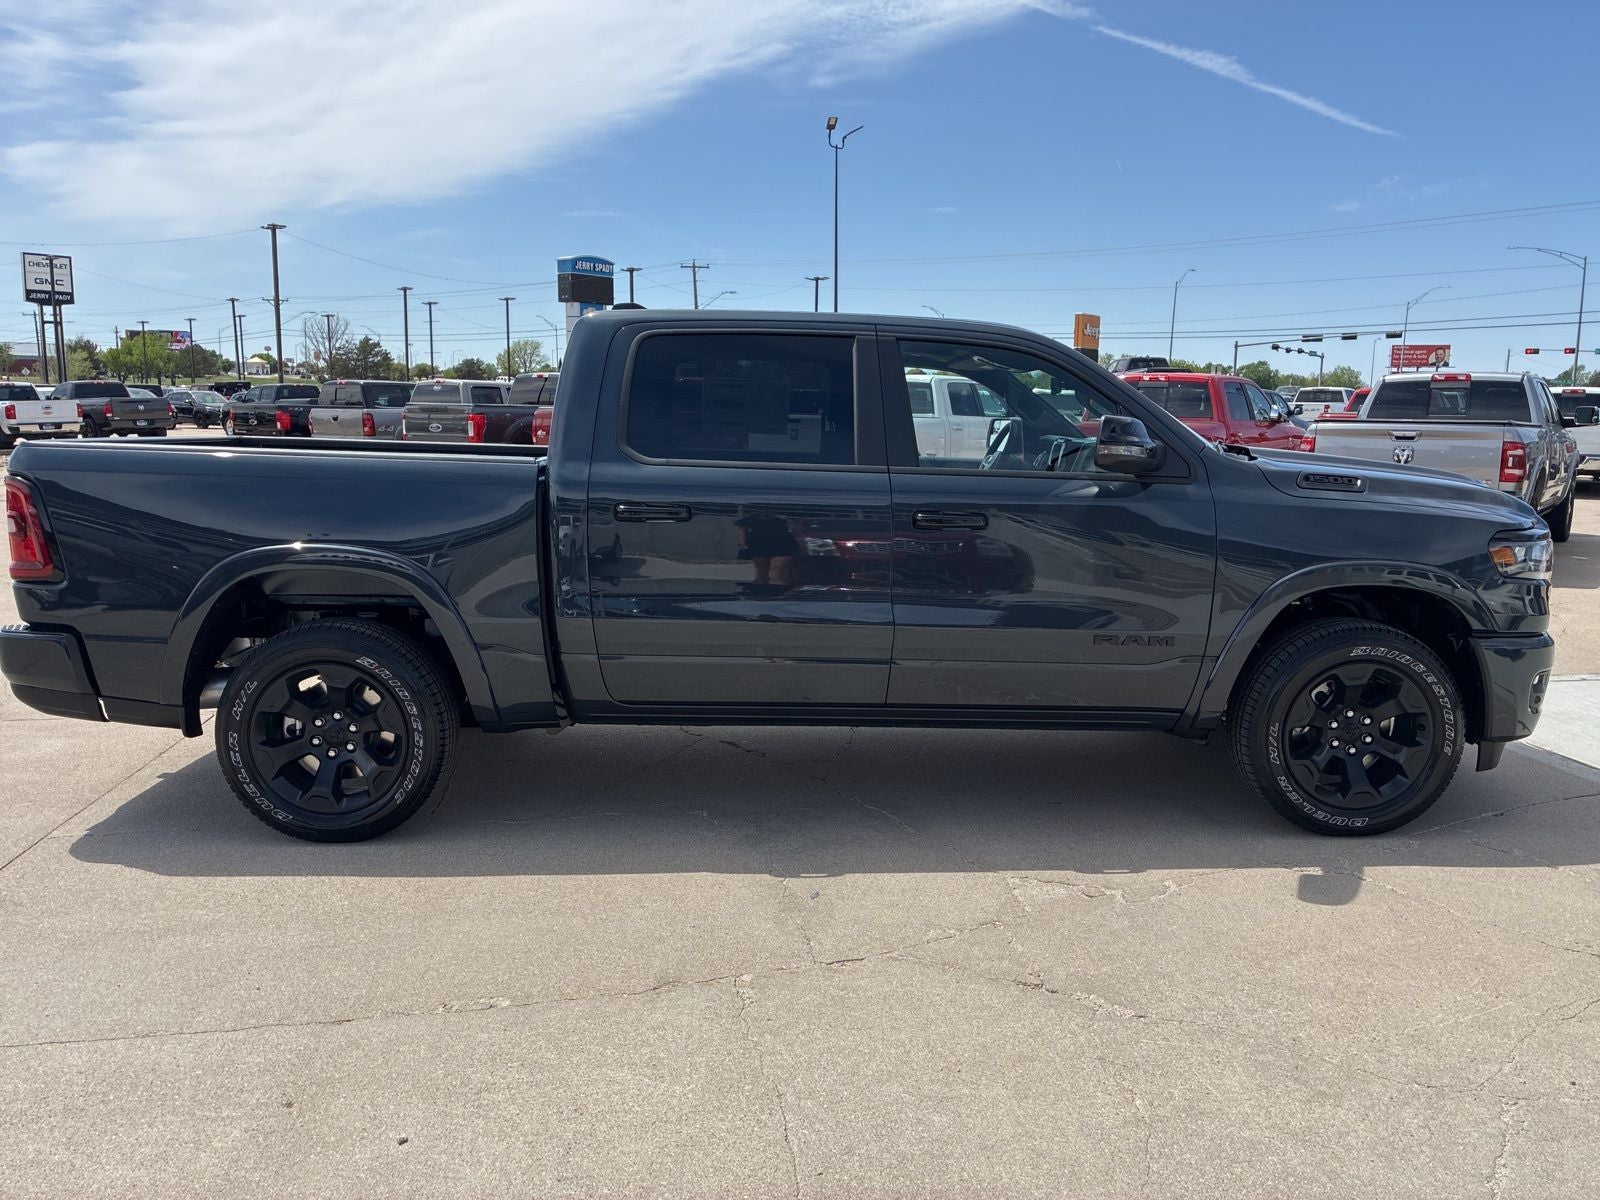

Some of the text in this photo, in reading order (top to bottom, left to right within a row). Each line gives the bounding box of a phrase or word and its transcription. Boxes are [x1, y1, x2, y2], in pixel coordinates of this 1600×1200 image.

[575, 260, 613, 273] JERRY SPADY
[29, 292, 50, 300] JERRY
[1304, 474, 1355, 485] 1500
[1093, 634, 1176, 647] RAM
[1349, 646, 1456, 756] BRIDGESTONE
[355, 655, 425, 804] BRIDGESTONE
[229, 731, 293, 822] DUELER
[1277, 776, 1369, 827] DUELER
